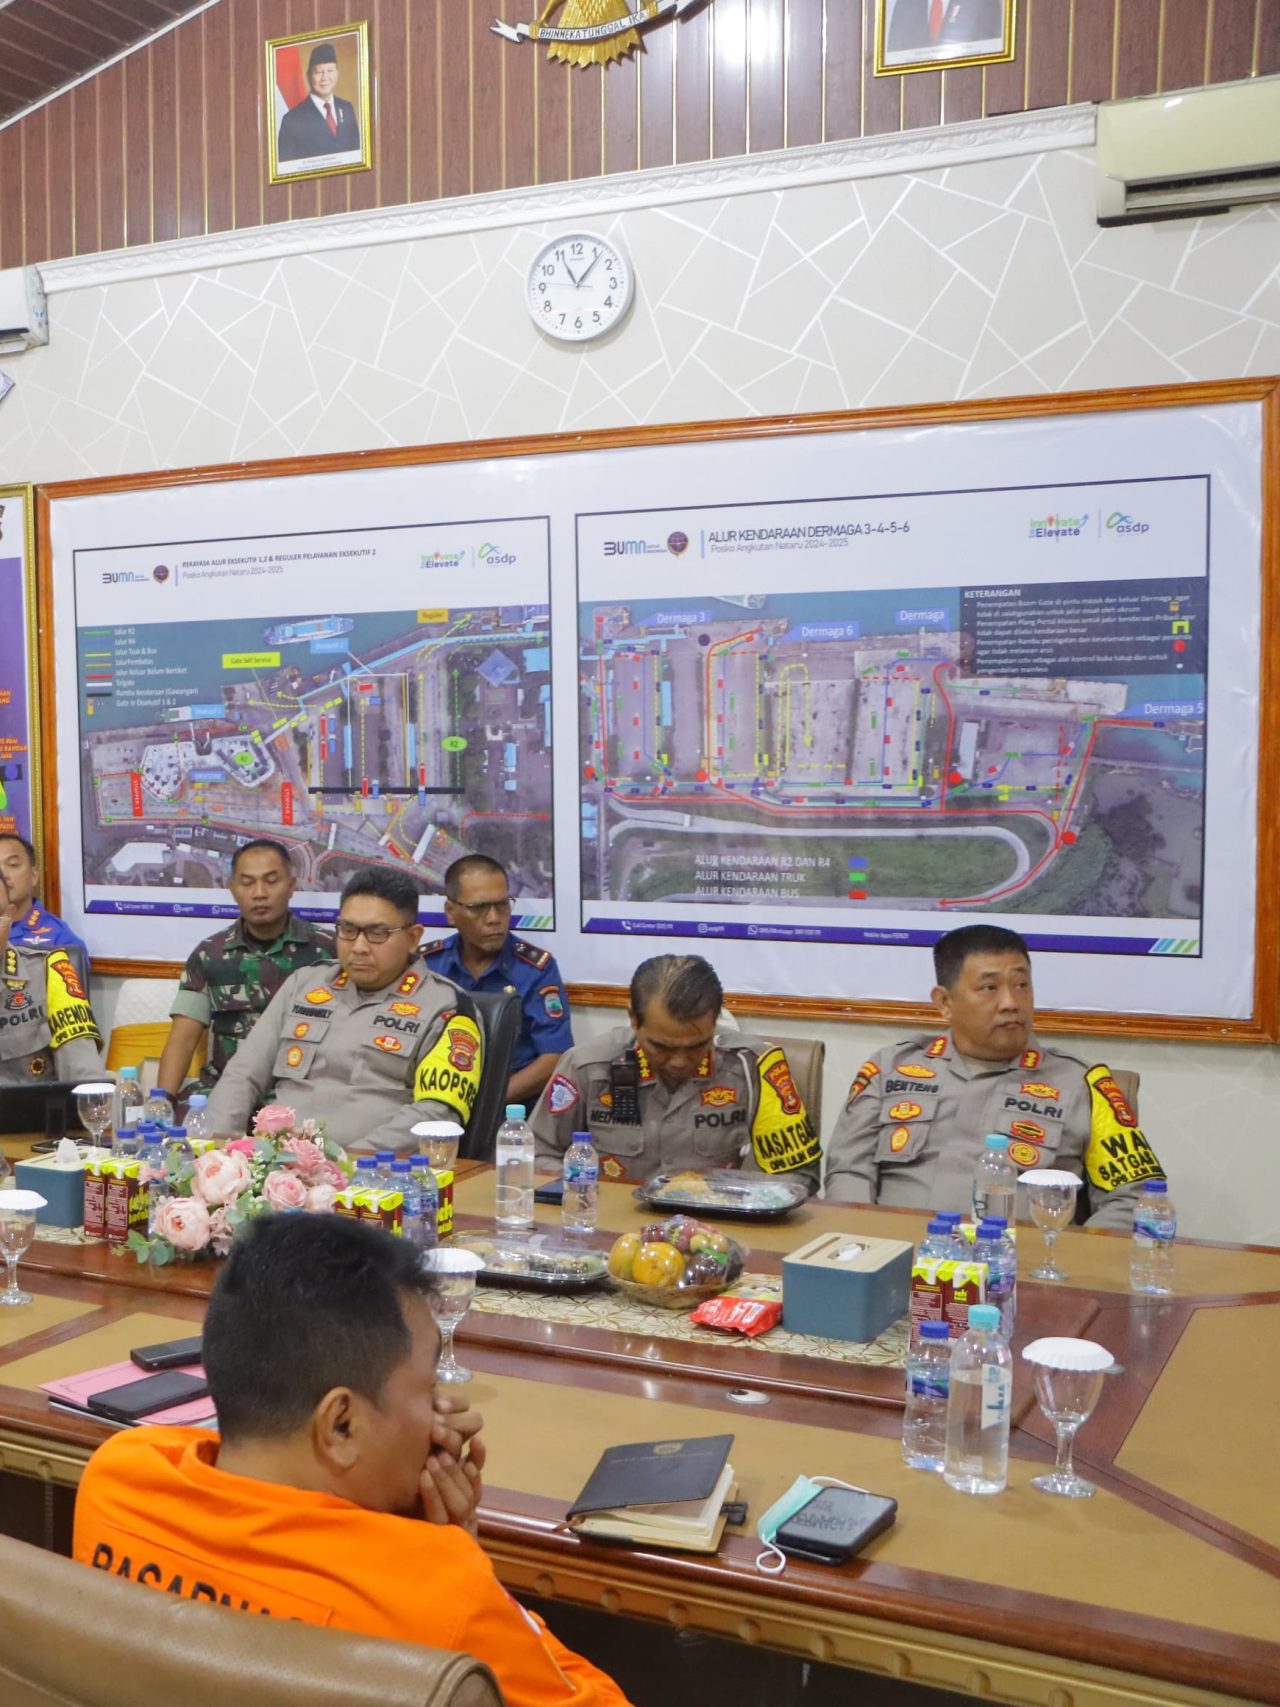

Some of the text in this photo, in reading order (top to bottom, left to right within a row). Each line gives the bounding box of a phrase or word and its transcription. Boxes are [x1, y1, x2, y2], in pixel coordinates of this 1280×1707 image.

[540, 12, 647, 39] BHINNEKA TUNGGAL IKA
[555, 249, 565, 261] 11
[570, 243, 584, 255] 12
[592, 247, 598, 258] 1
[541, 264, 555, 276] 10
[604, 259, 613, 270] 2
[538, 282, 547, 294] 9
[609, 277, 617, 289] 3
[543, 300, 552, 312] 8
[604, 295, 613, 308] 4
[559, 313, 566, 325] 7
[574, 317, 583, 328] 6
[593, 311, 600, 322] 5
[708, 521, 910, 543] ALUR KENDARAAN DERMAGA 3-4-5-6
[1035, 527, 1080, 538] Elevate
[1116, 521, 1149, 533] asdp
[604, 540, 646, 556] BUMN
[711, 537, 849, 553] Posko Angkutan Nataru 2024-2025
[211, 559, 226, 567] ALUR
[227, 556, 257, 566] EKSEKUTIF
[274, 553, 301, 562] REGULER
[302, 551, 337, 561] PELAYANAN
[338, 549, 370, 559] EKSEKUTIF
[425, 559, 459, 568] Elevate
[486, 552, 517, 565] asdp
[964, 589, 1021, 599] KETERANGAN
[657, 612, 705, 625] Dermaga 3
[900, 610, 945, 622] Dermaga
[801, 626, 853, 638] Dermaga 6
[1144, 702, 1204, 716] Dermaga 5
[695, 855, 831, 868] ALUR KENDARAAN R2 DAN R4
[695, 870, 806, 883] ALUR KENDARAAN TRUK
[695, 886, 800, 899] ALUR KENDARAAN BUS
[373, 1015, 420, 1034] POLRI
[1004, 1097, 1063, 1119] POLRI
[695, 1110, 746, 1128] POLRI
[437, 1198, 453, 1221] eh
